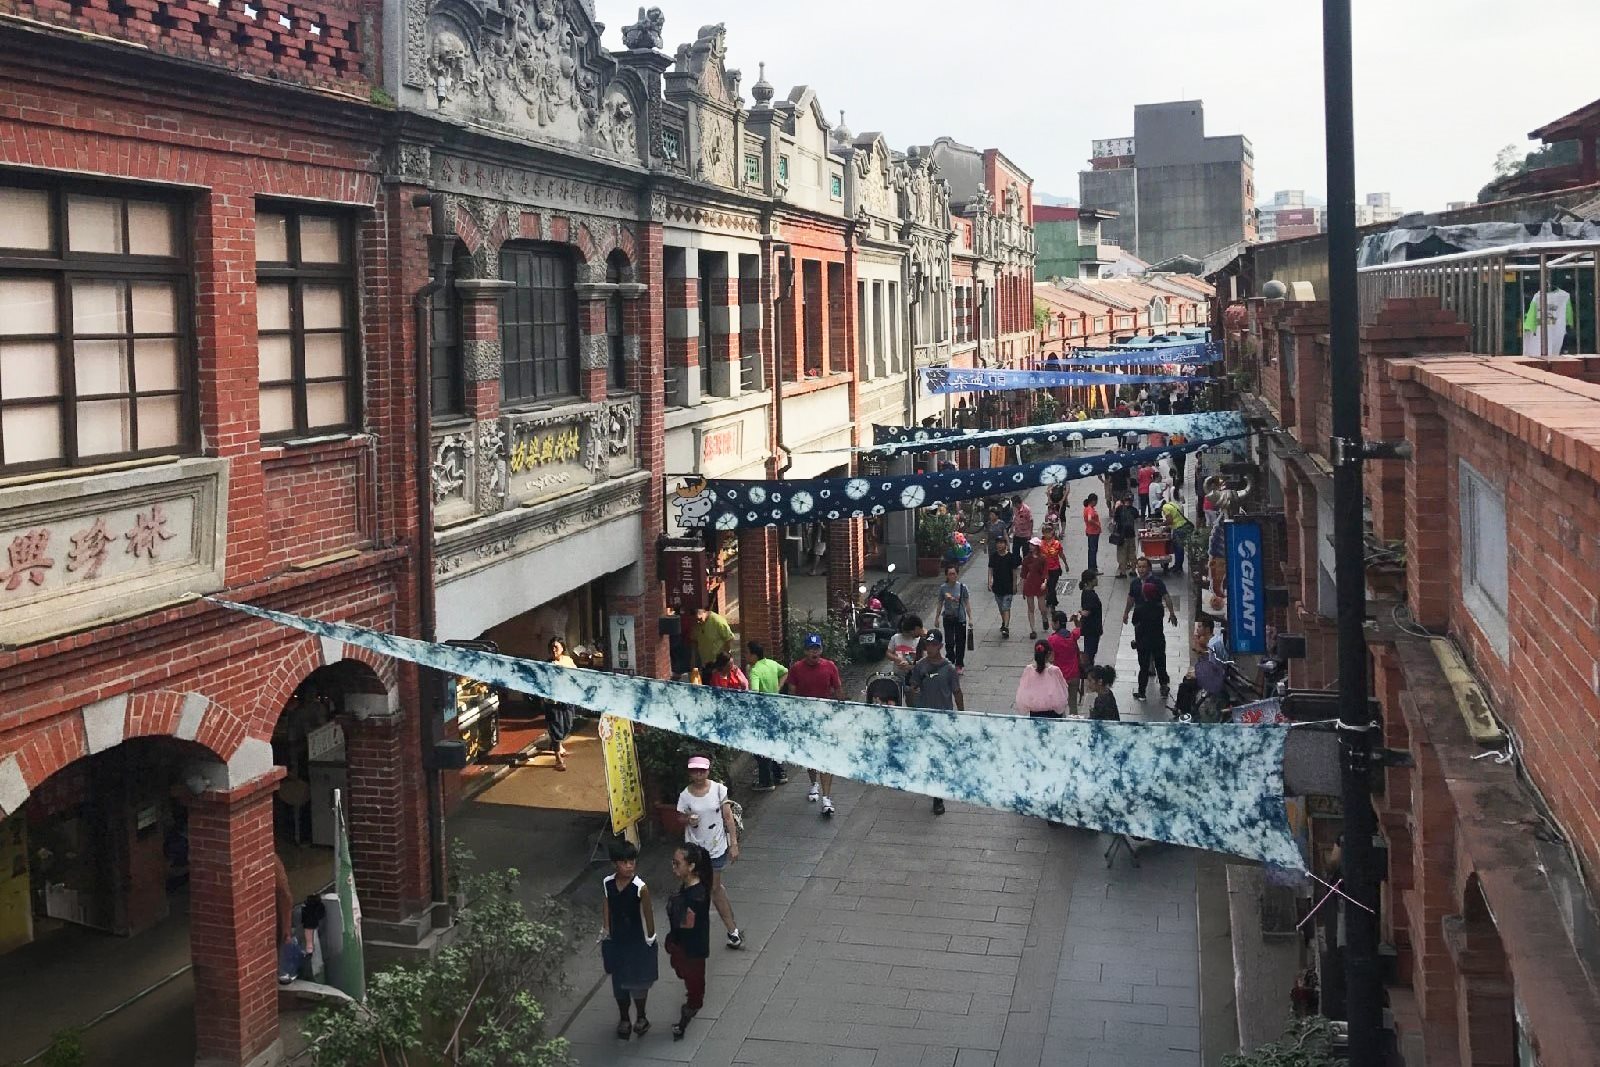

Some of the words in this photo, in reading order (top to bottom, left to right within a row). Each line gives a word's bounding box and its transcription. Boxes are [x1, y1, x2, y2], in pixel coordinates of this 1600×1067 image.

[680, 555, 695, 596] 金三峽
[1240, 560, 1257, 636] GIANT
